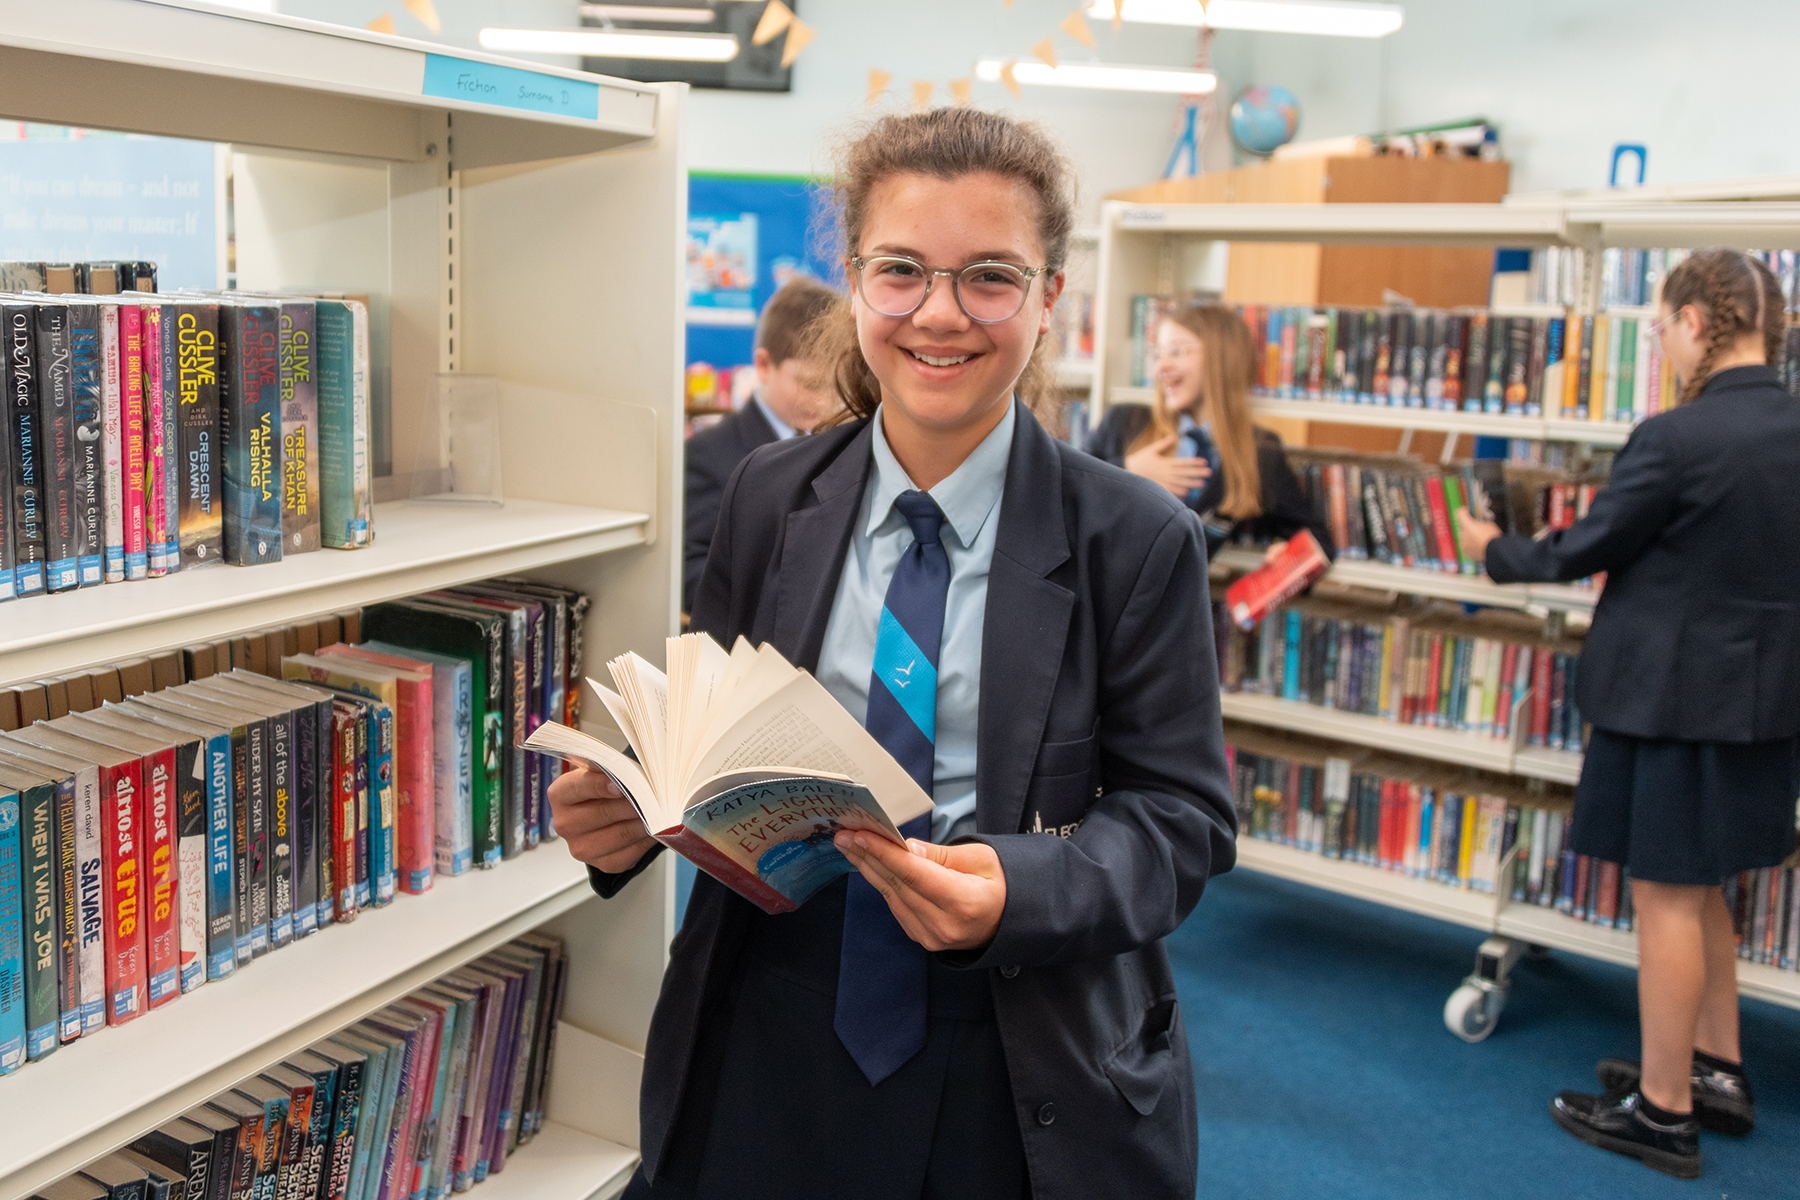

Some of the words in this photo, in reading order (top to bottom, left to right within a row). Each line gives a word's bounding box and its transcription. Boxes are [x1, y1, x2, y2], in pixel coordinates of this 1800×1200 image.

[456, 73, 498, 94] Fiction
[517, 85, 555, 104] Surname
[561, 89, 570, 105] D
[51, 180, 76, 196] can
[78, 174, 124, 197] dream
[140, 173, 168, 198] and
[172, 181, 200, 197] not
[91, 215, 125, 238] your
[184, 210, 200, 236] If
[12, 313, 29, 354] OLD
[51, 315, 62, 347] THE
[127, 333, 141, 352] THE
[163, 316, 172, 354] Vanessa
[72, 326, 99, 422] Hidden
[128, 356, 141, 392] BAKING
[164, 355, 173, 382] Curtis
[178, 313, 198, 405] CUSSLER
[195, 330, 215, 386] CLIVE
[242, 315, 260, 405] CUSSLER
[258, 331, 277, 386] CLIVE
[292, 330, 310, 383] CLIVE
[14, 354, 32, 407] MAGIC
[48, 347, 70, 408] NAMED
[128, 394, 142, 416] LIFE
[152, 413, 164, 437] DAYS
[128, 419, 143, 435] OF
[285, 434, 295, 459] OF
[20, 413, 34, 487] MARIANNE
[55, 415, 67, 487] MARIANNE
[129, 435, 143, 469] AMELIE
[250, 428, 261, 488] RISING
[260, 411, 273, 502] VALHALLA
[85, 445, 97, 504] MARIANNE
[109, 467, 119, 501] Vanessa
[130, 472, 143, 492] DAY
[155, 465, 164, 496] Vanessa
[189, 450, 200, 500] DAWN
[199, 431, 211, 514] CRESCENT
[285, 461, 296, 510] KHAN
[295, 426, 308, 516] TREASURE
[23, 488, 37, 540] CURLEY
[58, 488, 69, 539] CURLEY
[87, 506, 98, 549] CURLEY
[110, 503, 121, 528] Curtis
[132, 504, 143, 529] VANESSA
[157, 498, 166, 522] Curtis
[133, 530, 143, 553] CURTIS
[512, 660, 525, 730] ARENA
[251, 727, 261, 776] UNDER
[275, 723, 287, 740] all
[275, 742, 288, 758] of
[456, 672, 471, 797] FROZEN
[212, 751, 228, 833] ANOTHER
[252, 777, 262, 797] MY
[275, 760, 288, 786] the
[60, 792, 72, 801] THE
[84, 783, 93, 812] keren
[115, 776, 136, 857] almost
[152, 763, 170, 843] almost
[252, 798, 262, 834] SKIN
[276, 788, 289, 838] above
[706, 788, 776, 821] KATYA
[32, 800, 49, 859] WHEN
[60, 800, 75, 870] YELLOWCAKE
[85, 813, 95, 840] david
[383, 828, 391, 853] TERRY
[726, 816, 760, 837] The
[33, 861, 49, 874] I
[214, 834, 228, 875] LIFE
[345, 842, 353, 866] TERRY
[153, 844, 171, 924] true
[238, 857, 246, 894] STEPHEN
[282, 878, 290, 911] JAMES
[35, 872, 52, 925] WAS
[64, 869, 77, 934] CONSPIRACY
[81, 857, 103, 949] SALVAGE
[116, 858, 137, 939] true
[239, 894, 247, 924] DAVIES
[251, 882, 260, 927] DAWSON
[258, 887, 267, 918] JAMES
[211, 913, 233, 928] KEREN
[213, 921, 232, 936] DAVID
[33, 930, 52, 972] JOE
[128, 944, 139, 975] Keren
[154, 934, 163, 962] David
[163, 928, 172, 958] Keren
[67, 955, 75, 989] STEPHEN
[118, 950, 128, 978] David
[1, 968, 11, 1015] DASHNER
[11, 971, 22, 1004] JAMES
[311, 1100, 324, 1141] DENNIS
[343, 1090, 355, 1131] DENNIS
[262, 1130, 276, 1172] DENNIS
[288, 1120, 302, 1161] DENNIS
[239, 1144, 254, 1187] DENNIS
[327, 1138, 343, 1199] BREAKERS
[335, 1134, 355, 1195] SECRET
